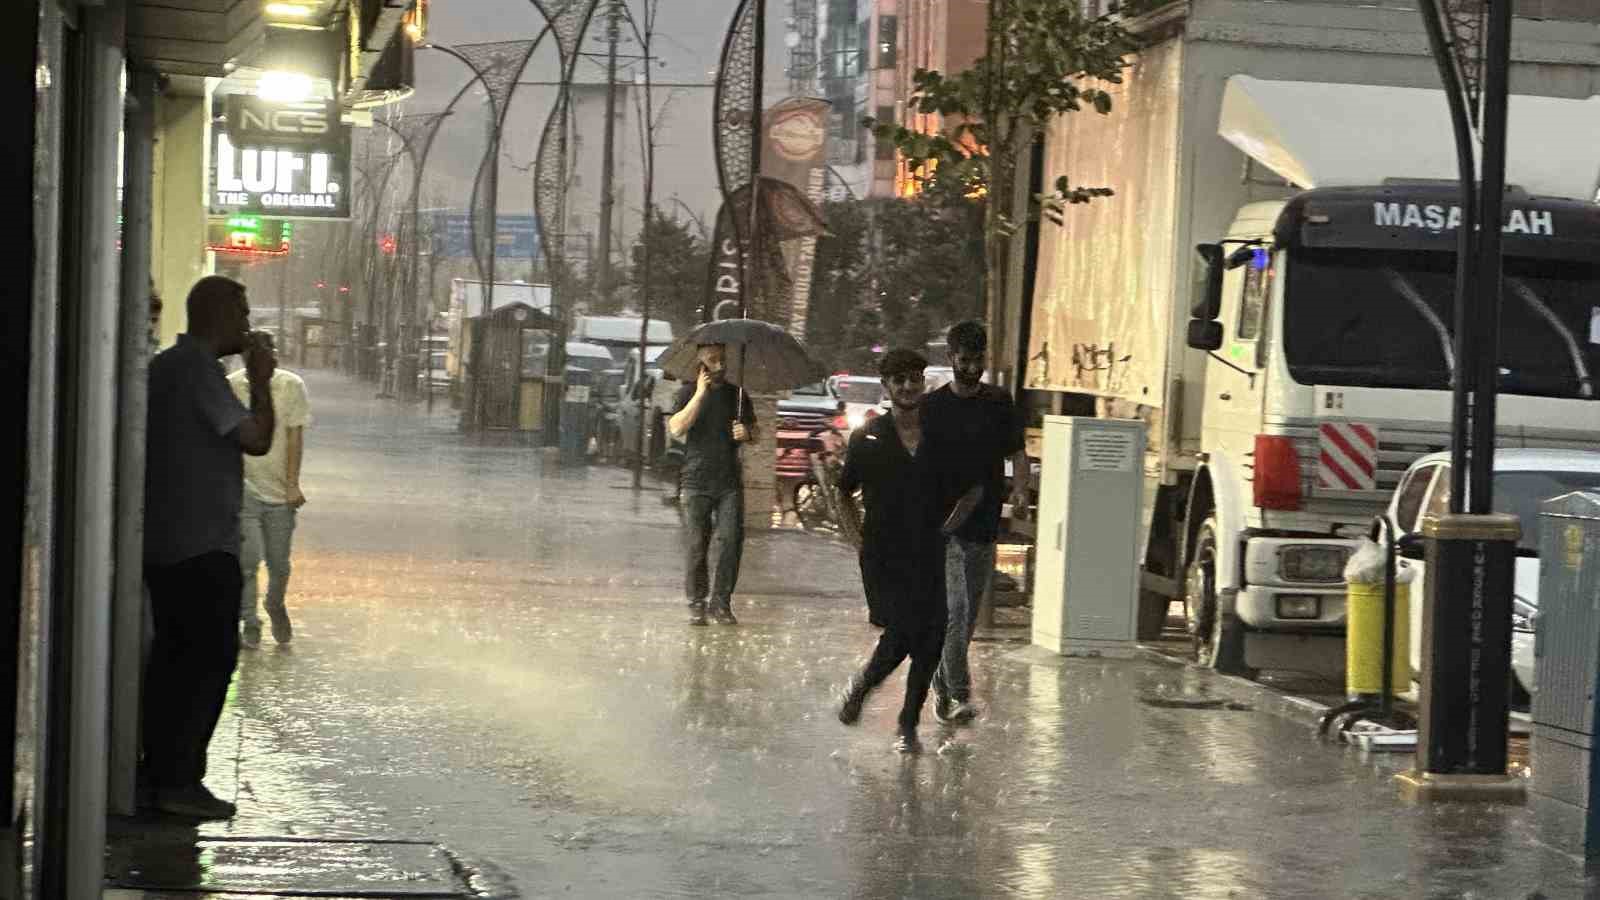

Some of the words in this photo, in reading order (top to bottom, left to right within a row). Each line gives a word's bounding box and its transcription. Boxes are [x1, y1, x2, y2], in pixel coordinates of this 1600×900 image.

[240, 109, 329, 133] NCS
[217, 192, 248, 205] THE
[261, 193, 336, 208] ORIGINAL
[1374, 202, 1553, 235] MAŞAAH
[799, 236, 816, 262] TAV
